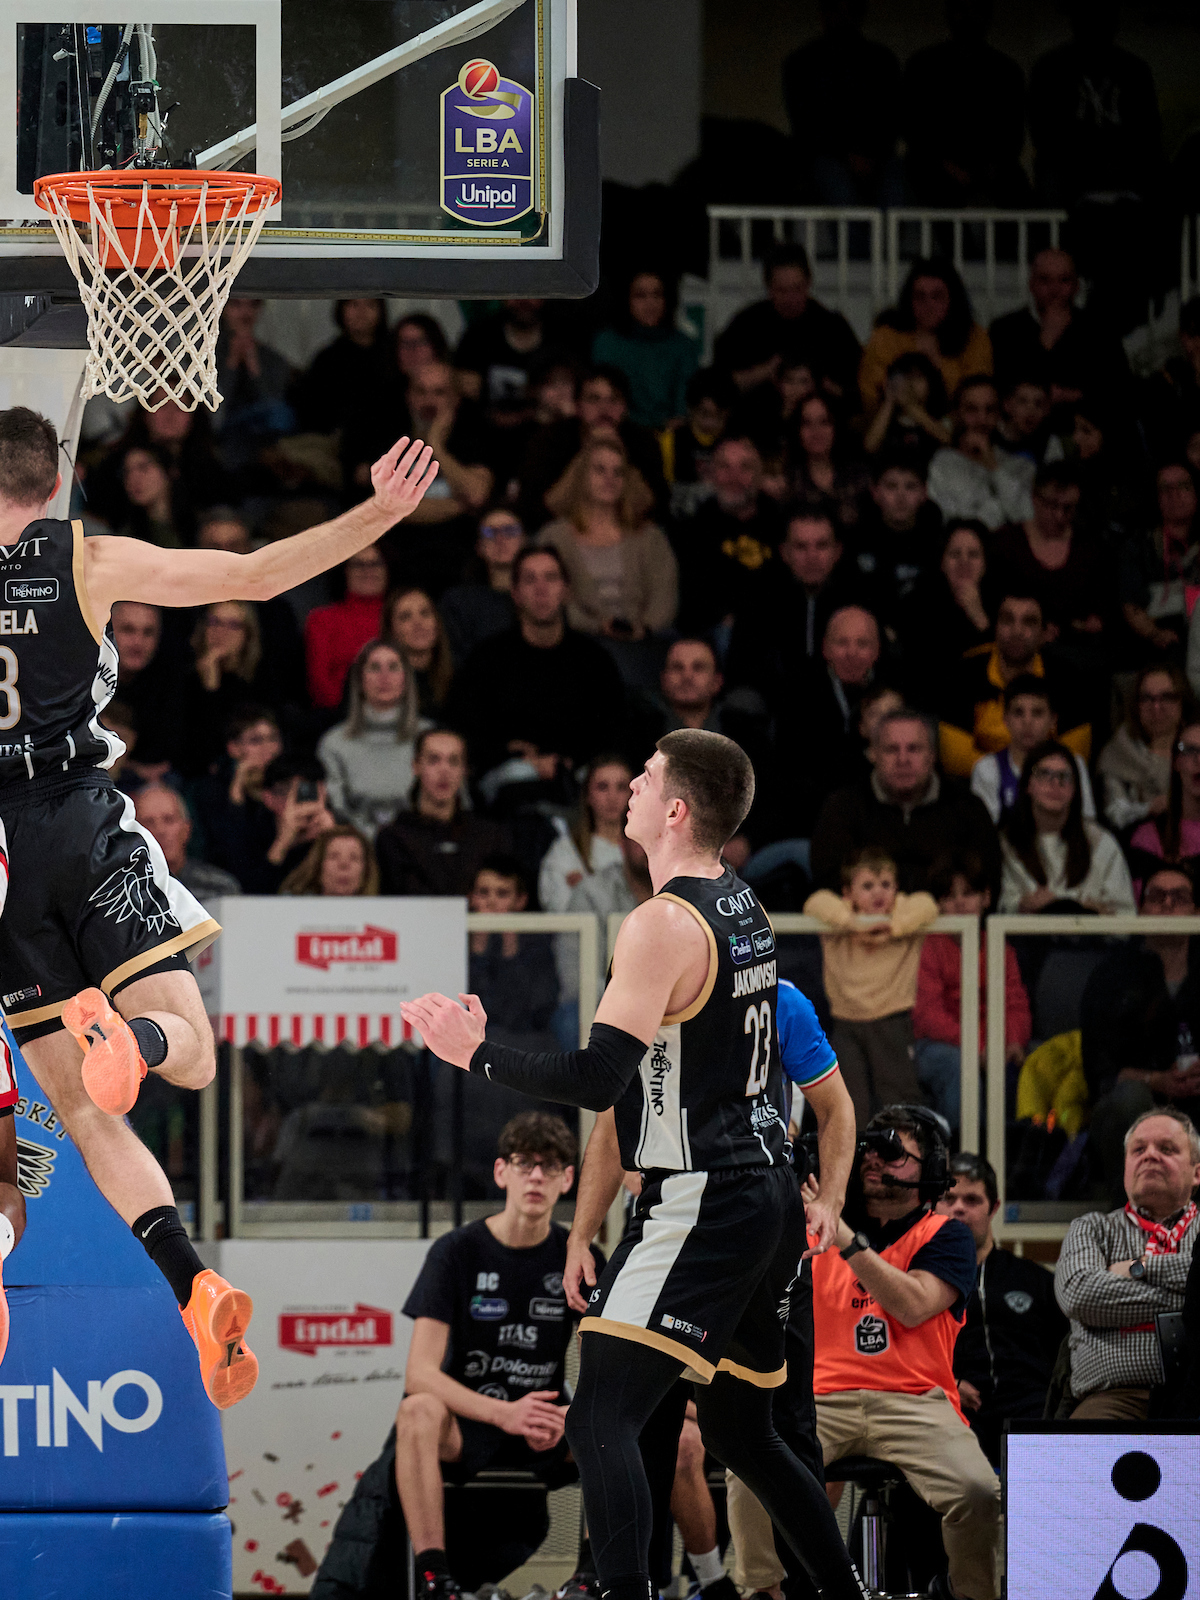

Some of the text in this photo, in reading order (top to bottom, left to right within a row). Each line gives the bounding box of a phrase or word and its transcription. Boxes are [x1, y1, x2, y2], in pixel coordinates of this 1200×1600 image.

[455, 127, 524, 154] LBA
[466, 158, 510, 168] SERIE A
[461, 183, 516, 209] Unipol
[10, 585, 53, 598] TRENTINO
[715, 887, 756, 917] CAVIT
[731, 959, 777, 999] JAKIMOVSKI
[9, 989, 25, 1004] BTS
[744, 1000, 772, 1097] 23
[649, 1041, 668, 1117] TRENTINO
[476, 1271, 500, 1292] BC
[499, 1323, 539, 1342] ITAS
[674, 1318, 693, 1335] BTS
[859, 1333, 885, 1346] LBA
